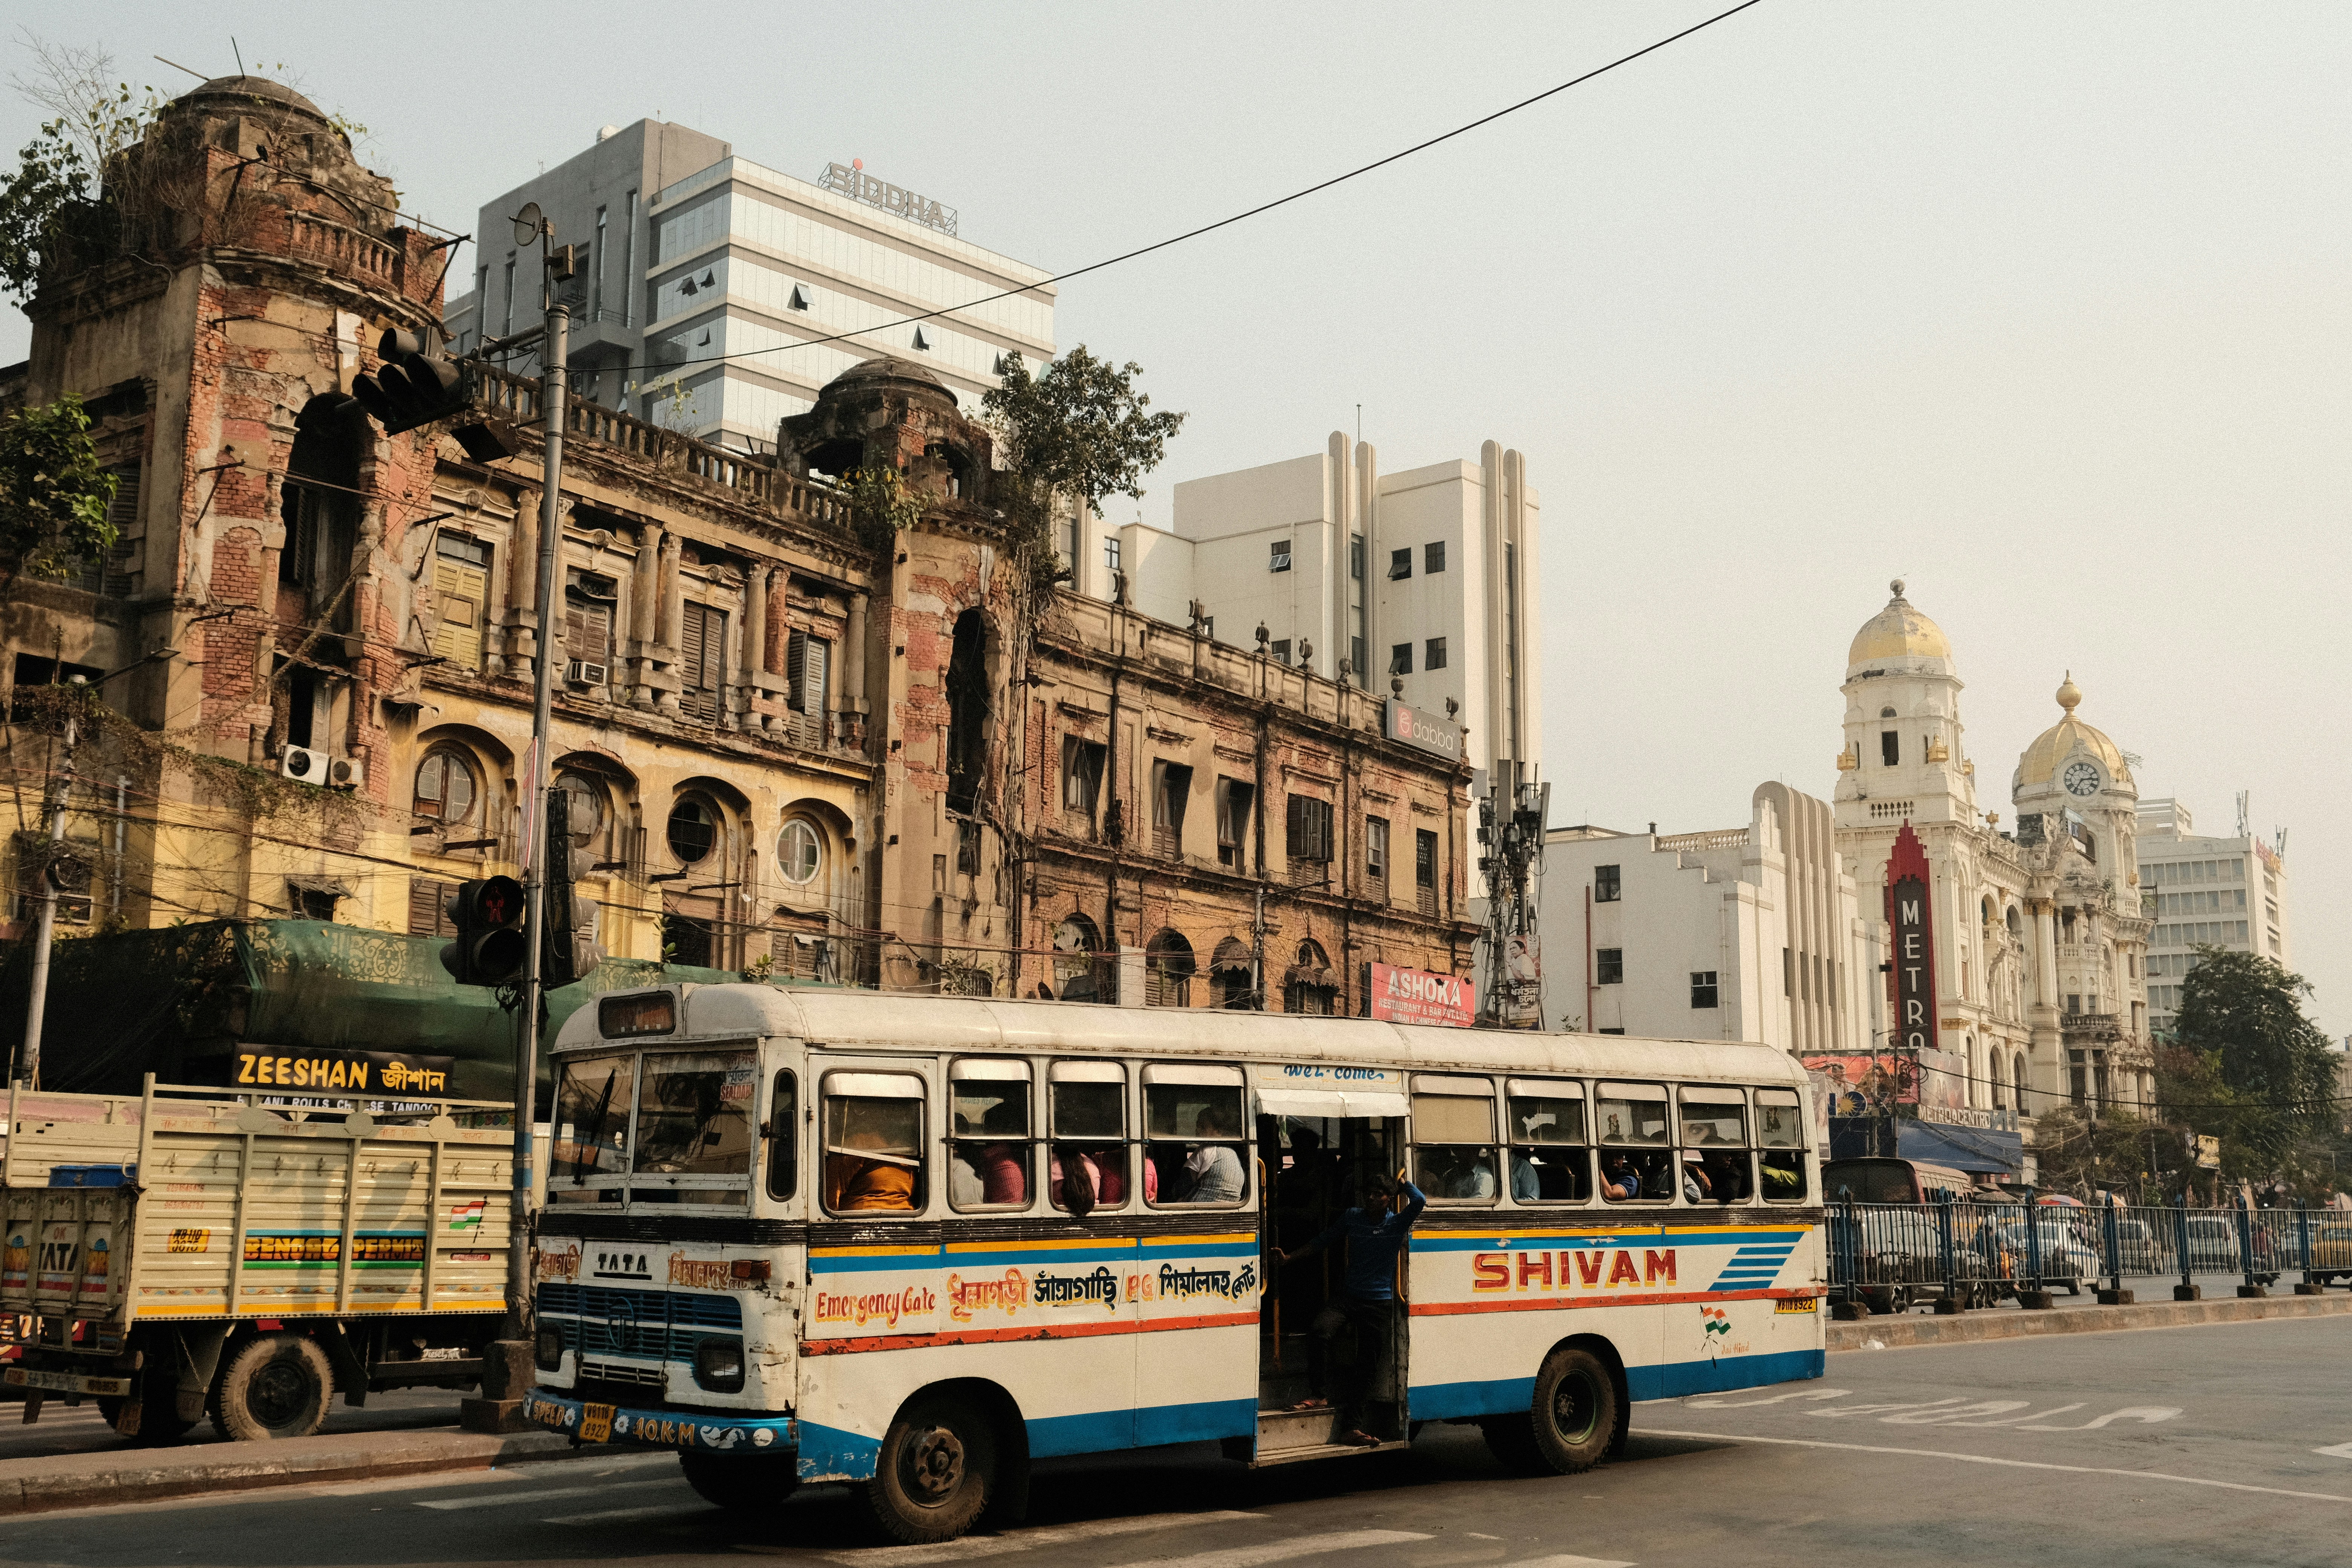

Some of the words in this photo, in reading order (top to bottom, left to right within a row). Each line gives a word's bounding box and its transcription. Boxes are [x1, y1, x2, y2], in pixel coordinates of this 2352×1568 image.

[830, 163, 945, 227] SIDDHA
[1413, 720, 1453, 751] dabba
[1387, 971, 1461, 1006] ASHOKA
[1902, 900, 1925, 1049] METRO
[1379, 998, 1421, 1014] RESTAURANT
[1429, 1006, 1442, 1017] BAR
[1393, 1012, 1410, 1023] INDIAN
[238, 1054, 368, 1089] ZEESHAN
[380, 1061, 446, 1092] জীশান
[292, 1098, 329, 1107] ROLLS
[54, 1227, 66, 1240] OK
[598, 1254, 648, 1272] TATA
[1472, 1249, 1677, 1293] SHIVAM
[815, 1291, 900, 1329] Emergency
[902, 1285, 936, 1315] Gate
[533, 1400, 565, 1427] SPEED
